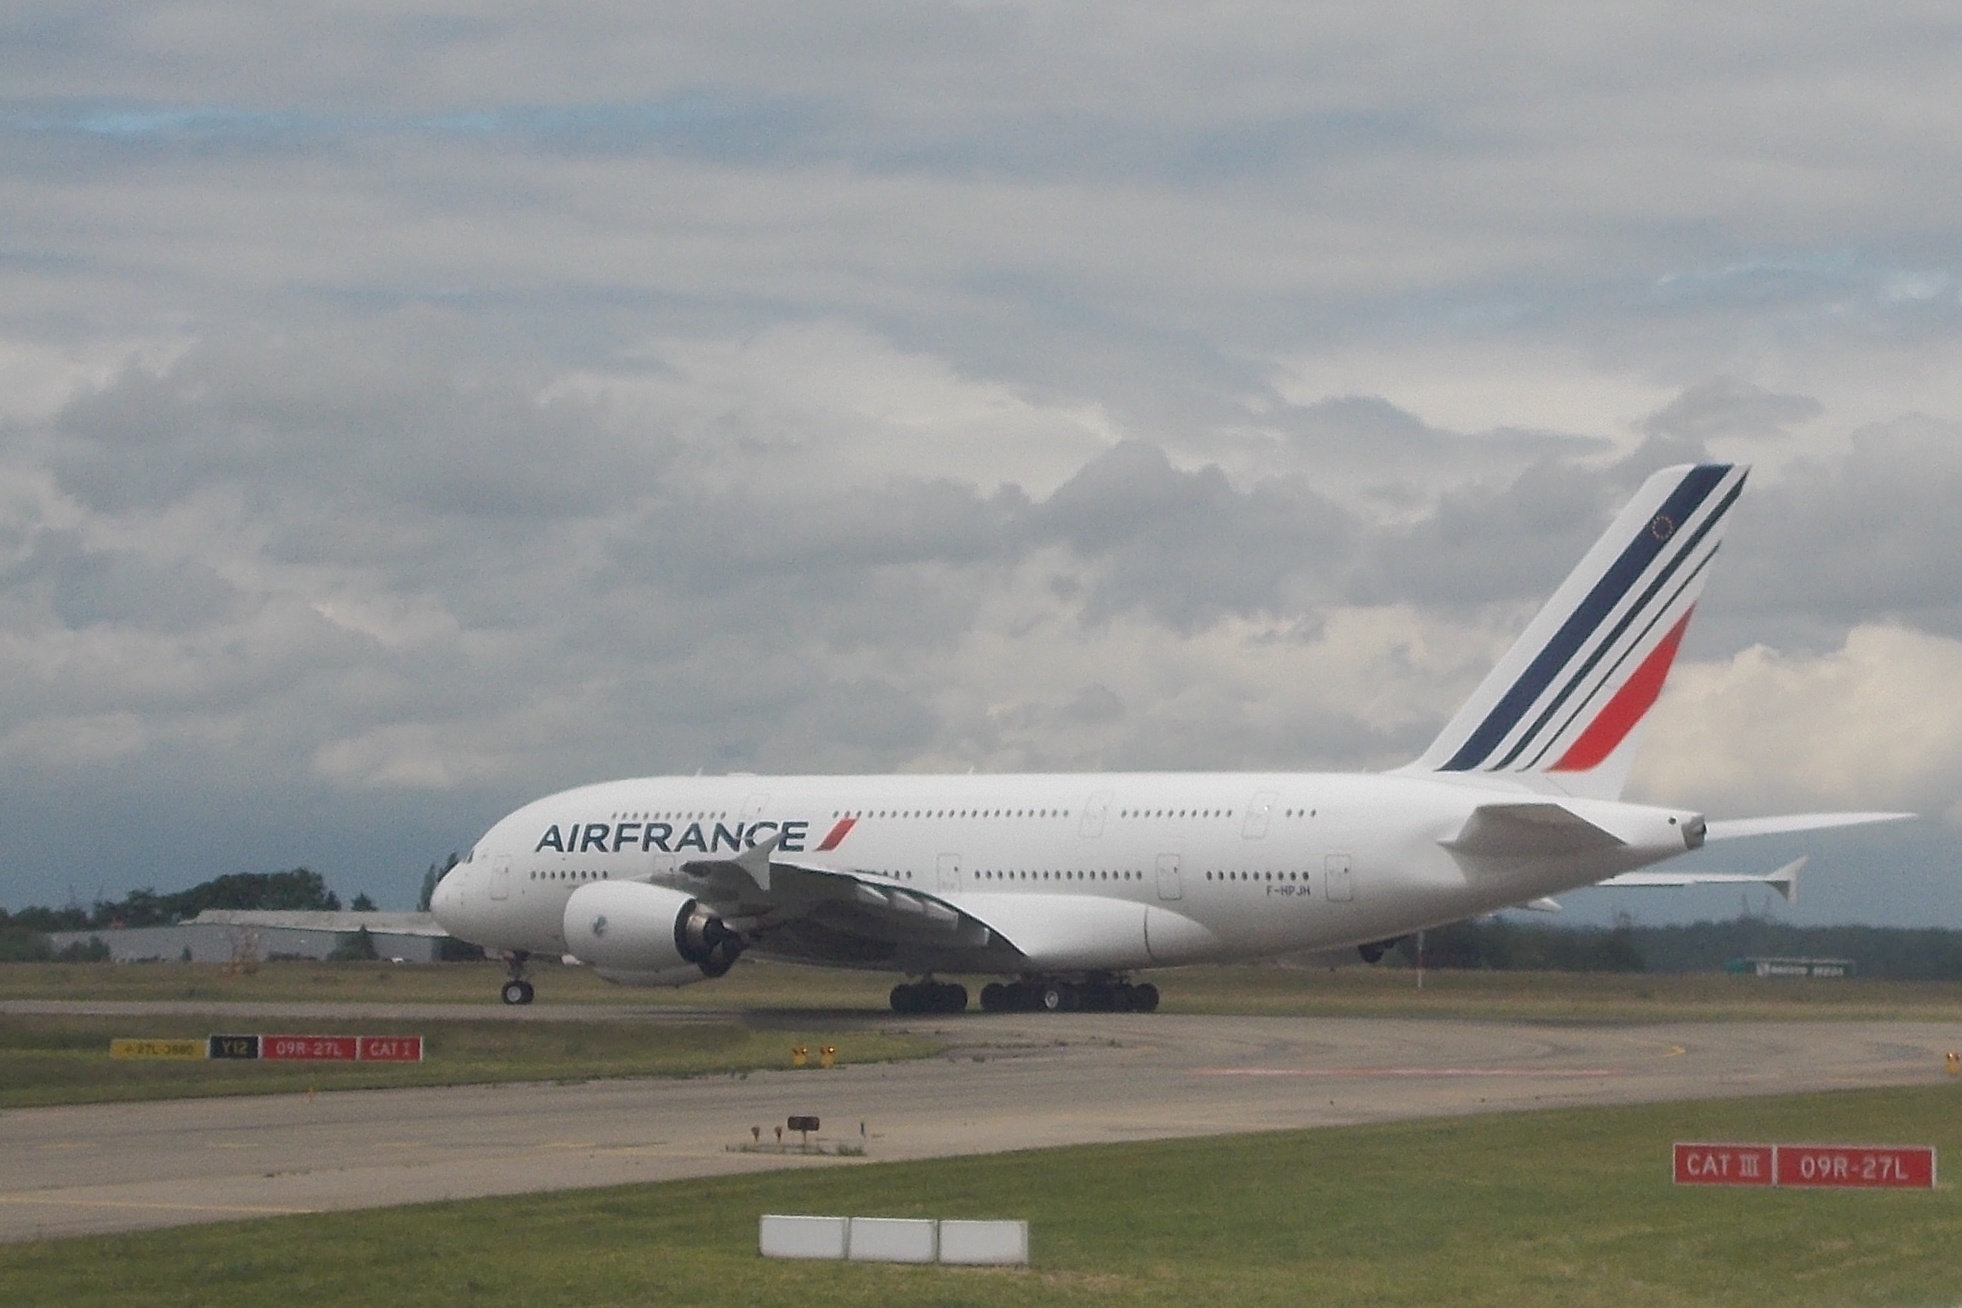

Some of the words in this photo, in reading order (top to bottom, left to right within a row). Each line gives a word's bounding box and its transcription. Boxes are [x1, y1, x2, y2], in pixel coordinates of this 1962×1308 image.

[535, 820, 809, 852] AIRFRANCE
[1266, 885, 1310, 896] F-HPJH
[221, 1040, 249, 1055] Y12
[275, 1041, 342, 1056] 09R-27L
[369, 1041, 396, 1056] CAT
[402, 1041, 411, 1056] I
[1686, 1153, 1729, 1176] CAT
[1738, 1154, 1760, 1177] III
[1801, 1155, 1909, 1180] 09R-27L
